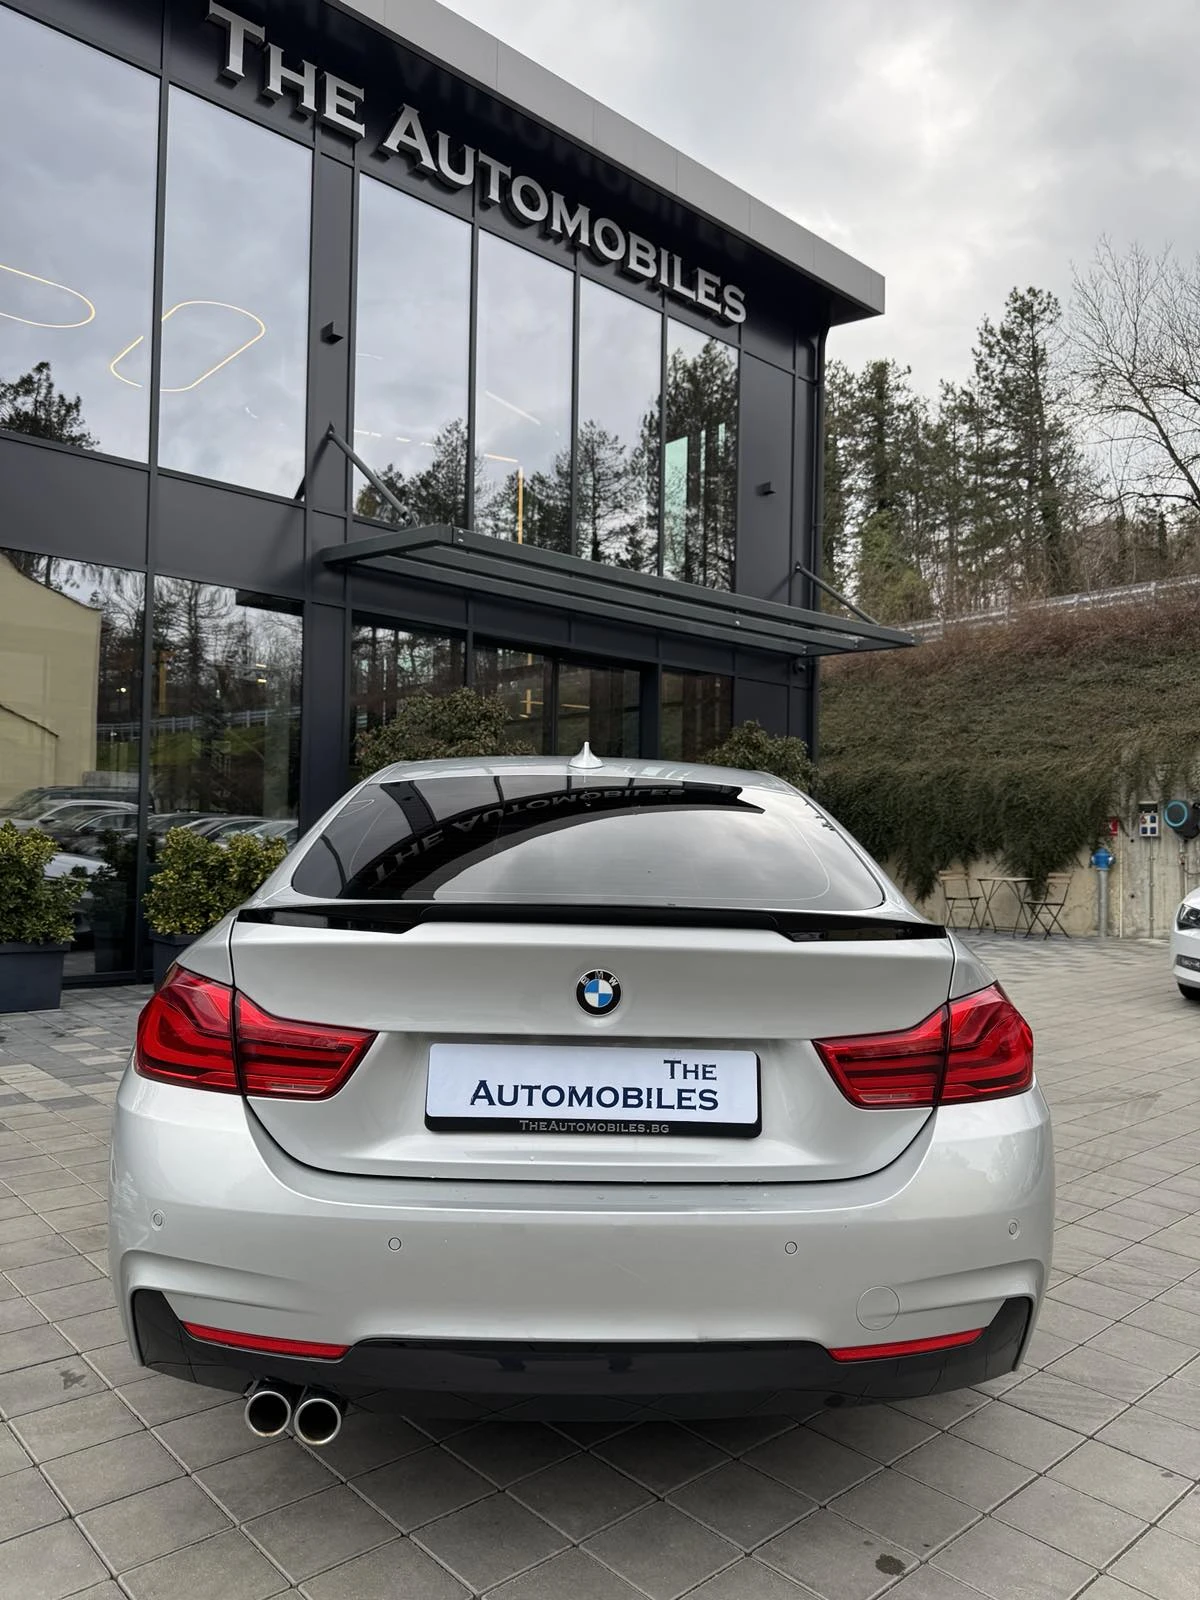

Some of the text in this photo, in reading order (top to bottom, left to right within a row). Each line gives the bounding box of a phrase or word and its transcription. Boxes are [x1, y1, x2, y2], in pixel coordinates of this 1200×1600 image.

[206, 2, 747, 326] THE AUTOMOBILES
[580, 970, 619, 987] BMW
[663, 1059, 718, 1081] THE
[470, 1080, 719, 1111] AUTOMOBILES
